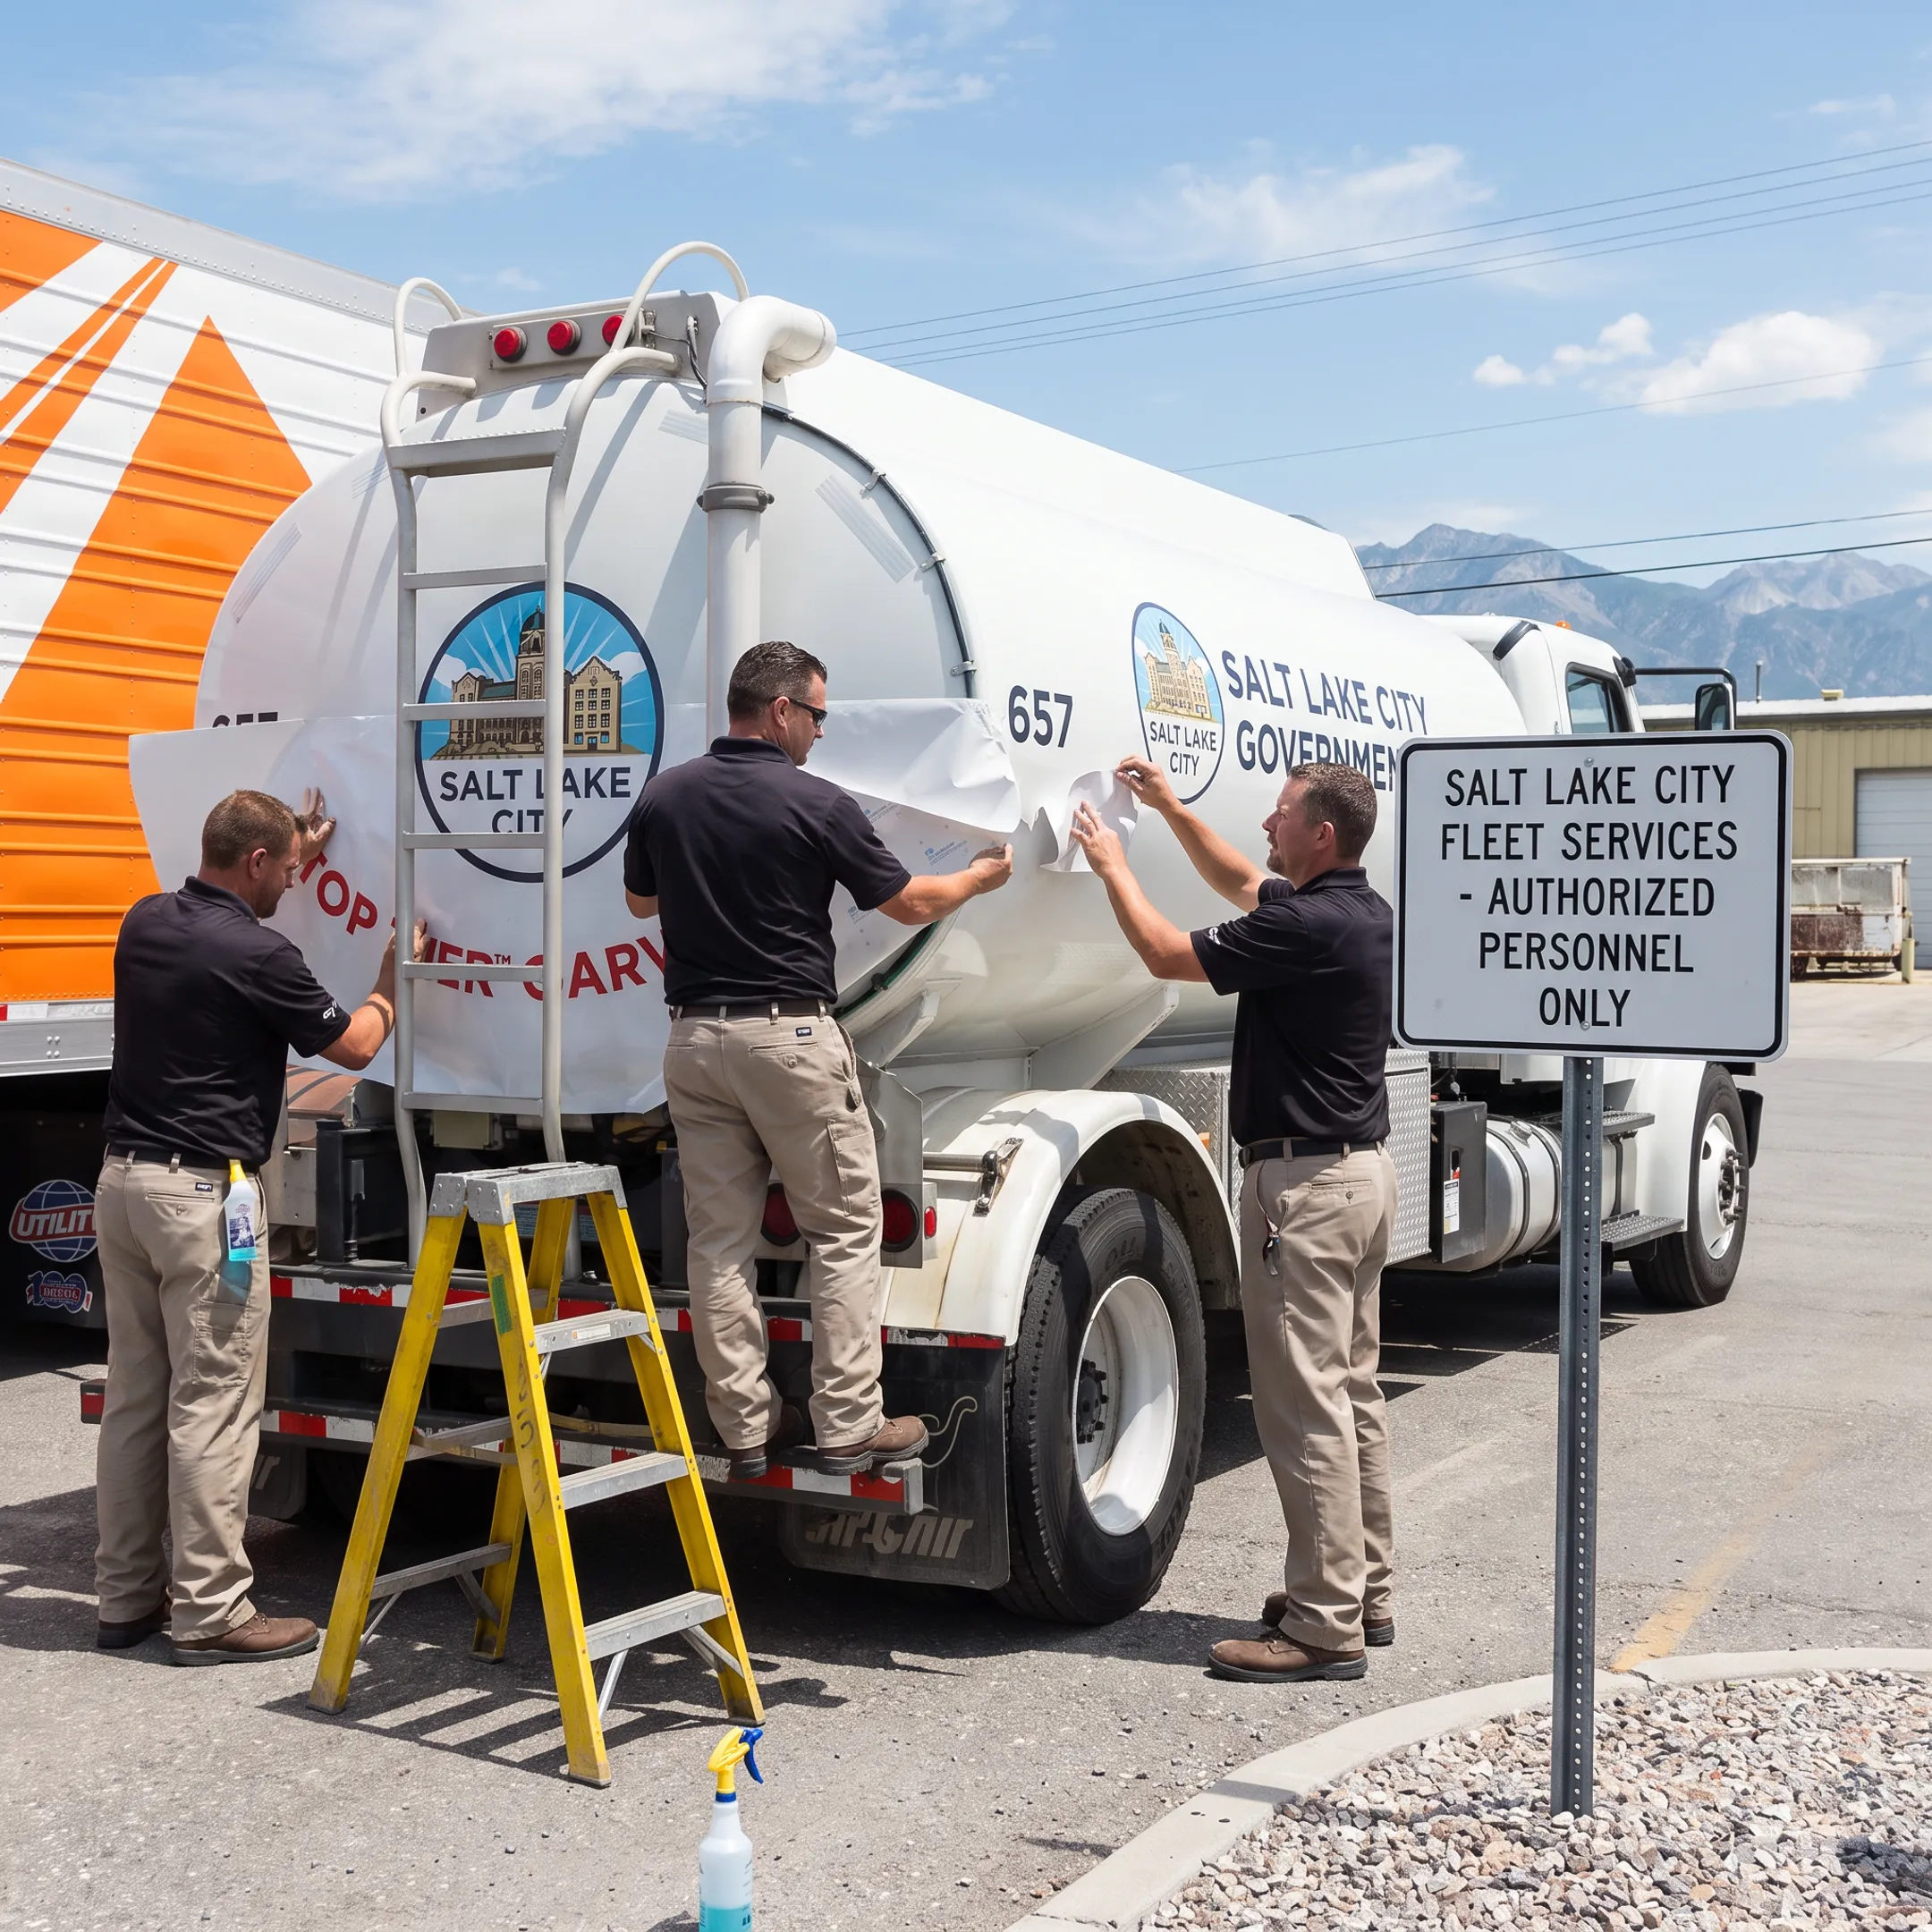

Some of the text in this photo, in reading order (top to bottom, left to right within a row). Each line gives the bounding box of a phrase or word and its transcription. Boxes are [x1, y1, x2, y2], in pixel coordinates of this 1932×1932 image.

[1222, 650, 1428, 735] SALT LAKE CITY
[1008, 685, 1073, 748] 657
[1150, 721, 1216, 751] SALT LAKE
[1169, 751, 1199, 776] CITY
[1236, 720, 1399, 792] GOVERNMEN
[440, 767, 631, 801] SALT LAKE
[1445, 765, 1735, 806] SALT LAKE CITY
[1441, 821, 1738, 860] FLEET SERVICES
[1487, 877, 1715, 917] AUTHORIZED
[1479, 932, 1694, 973] PERSONNEL
[1539, 987, 1631, 1028] ONLY
[16, 1208, 97, 1237] UTILIT
